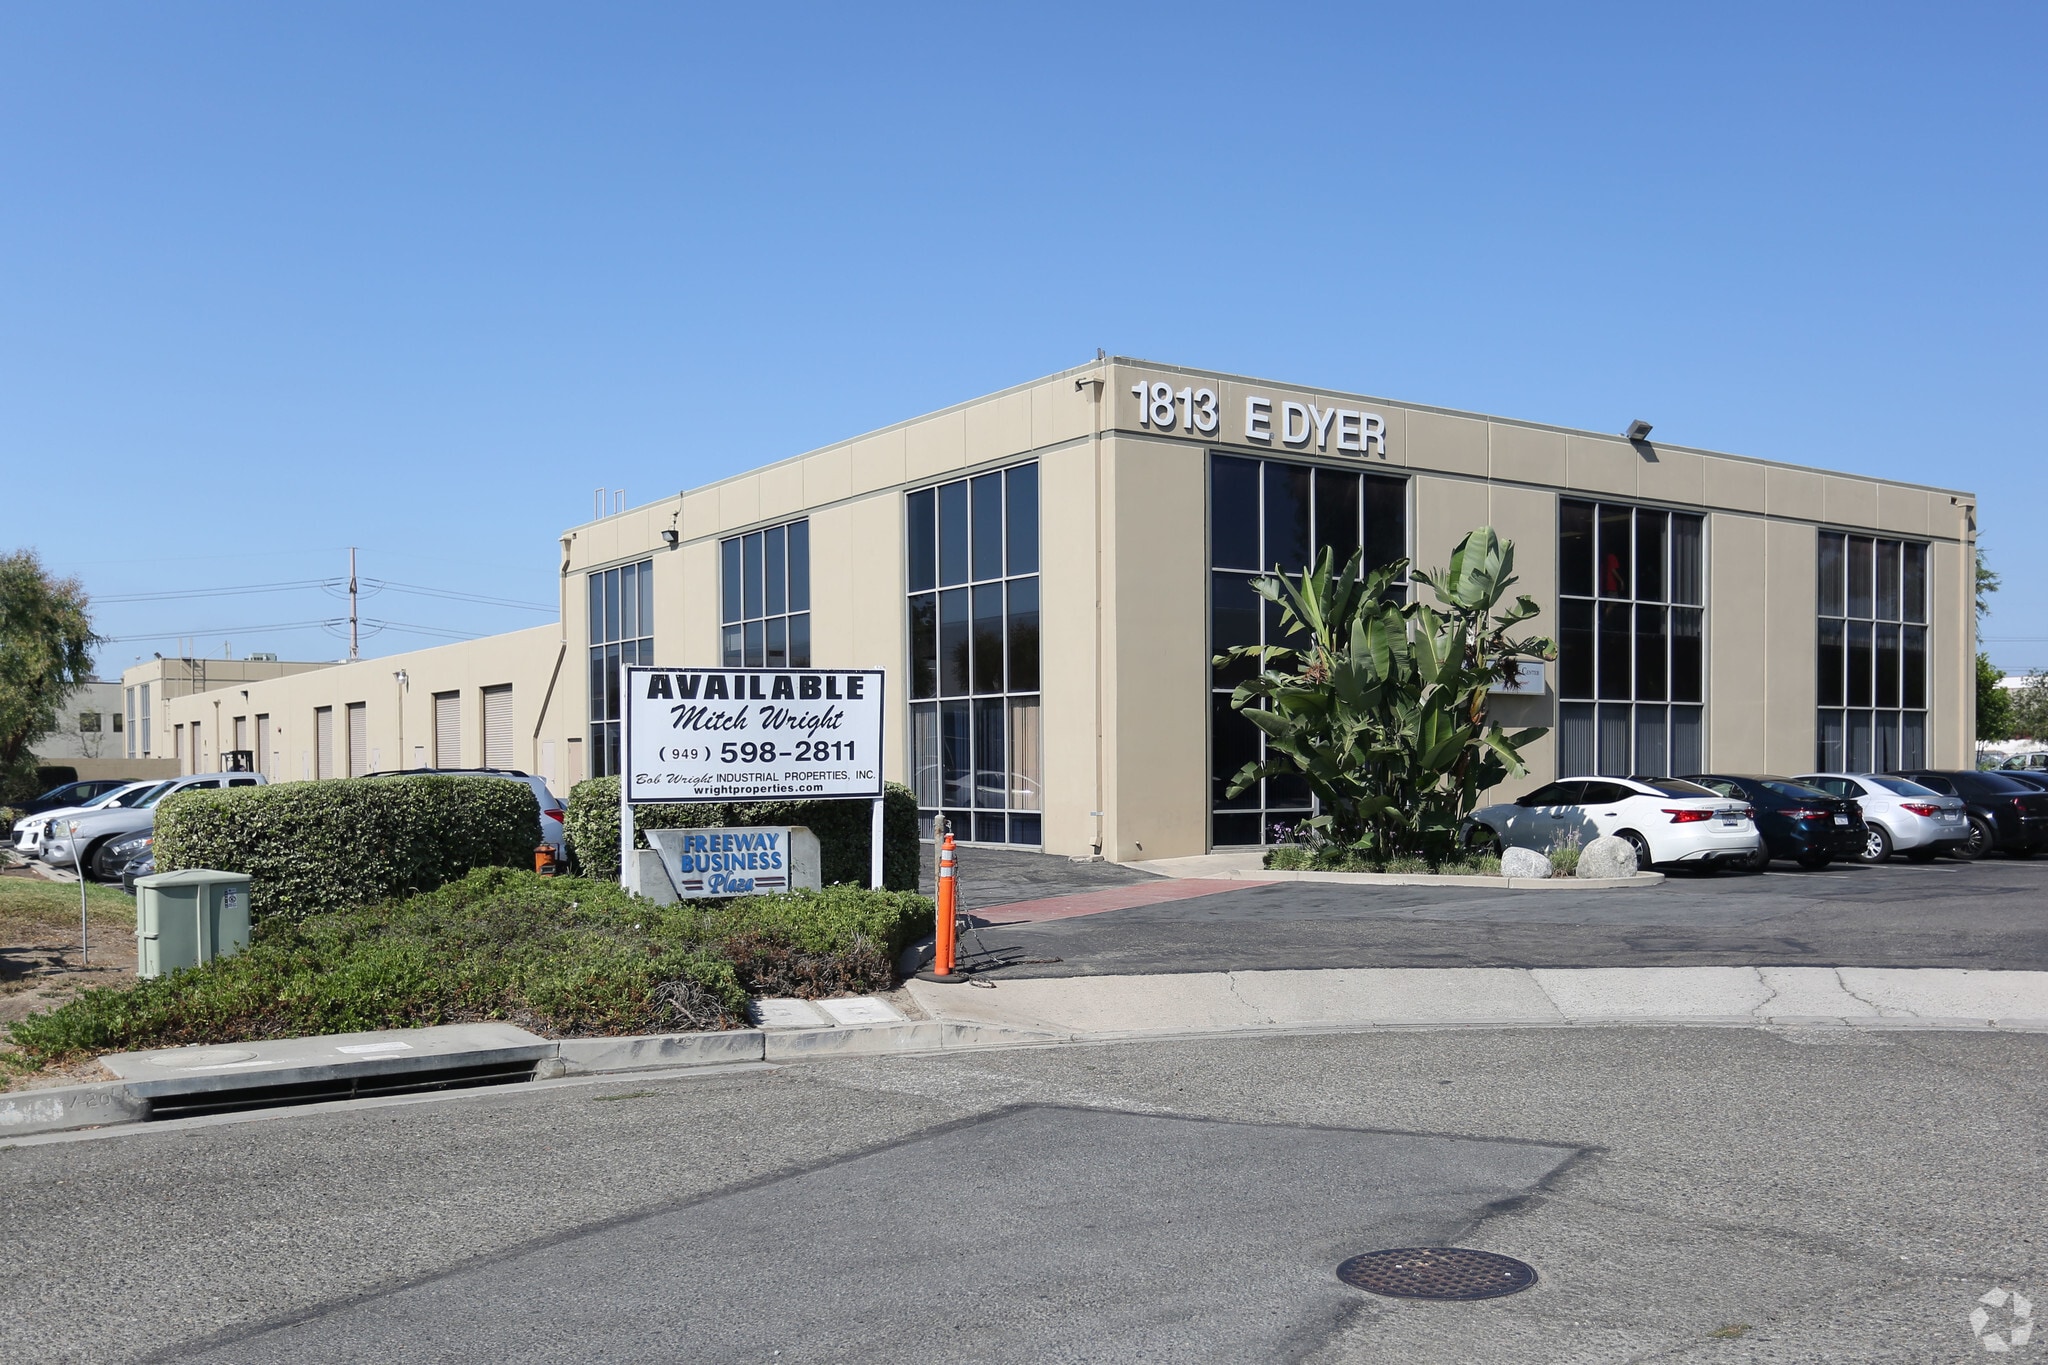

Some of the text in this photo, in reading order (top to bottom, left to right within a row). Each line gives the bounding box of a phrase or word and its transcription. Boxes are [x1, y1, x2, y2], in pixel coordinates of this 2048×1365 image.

[1131, 380, 1386, 455] 1813 E DYER
[647, 674, 864, 700] AVAILABLE
[670, 703, 844, 738] Mitch Wright
[720, 740, 855, 763] 598-2811
[635, 770, 876, 787] Bob Wright INDUSTRIAL PROPERTIES, INC.
[694, 783, 823, 796] wrightproperties.com
[684, 833, 780, 853] FREEWAY
[682, 852, 782, 873] BUSINESS
[708, 869, 755, 894] Plaza
